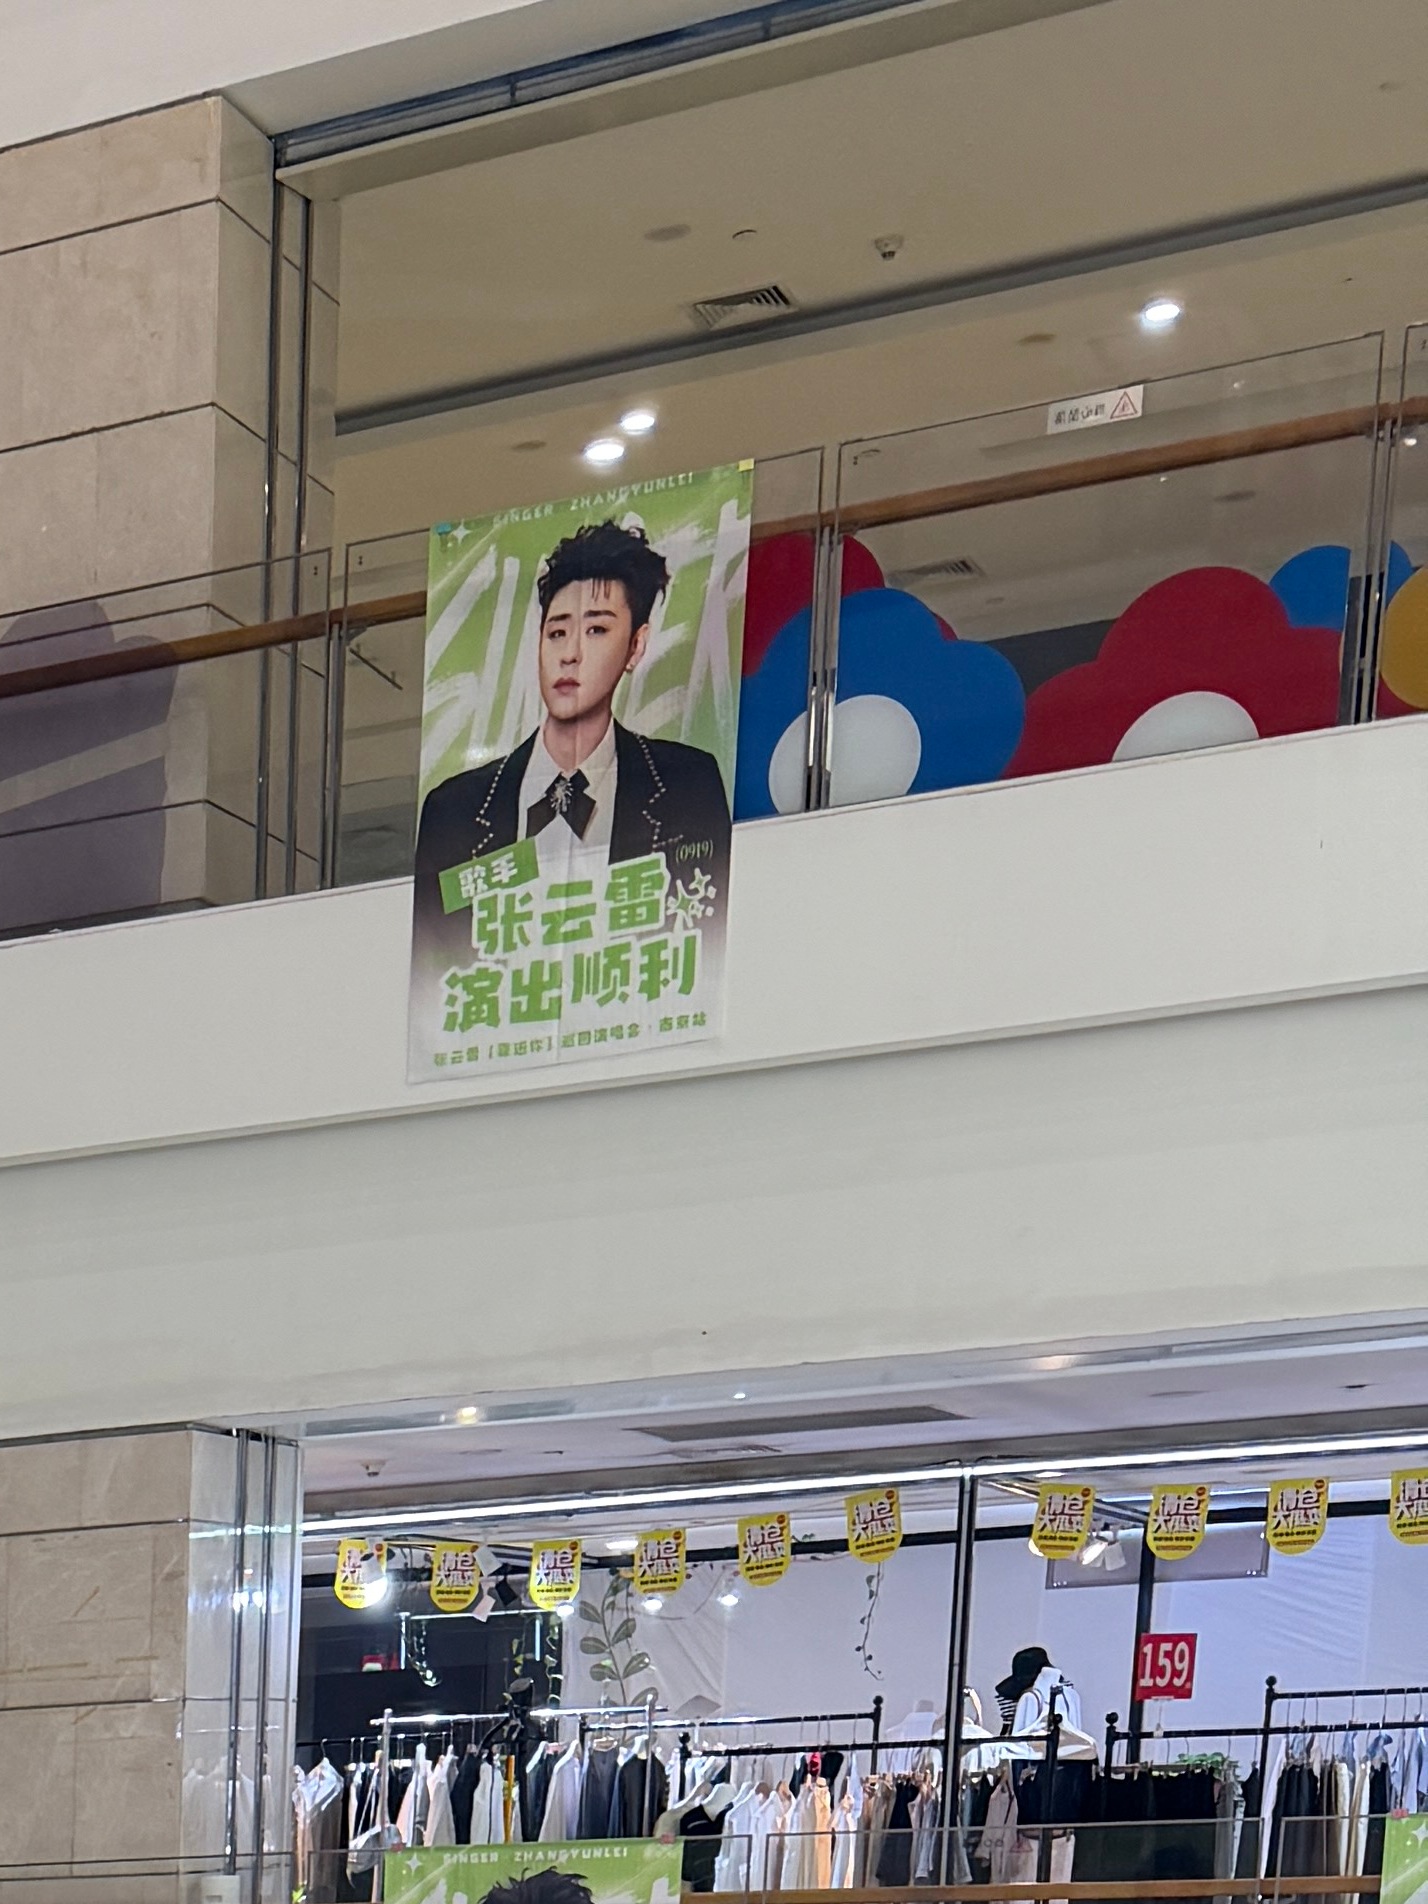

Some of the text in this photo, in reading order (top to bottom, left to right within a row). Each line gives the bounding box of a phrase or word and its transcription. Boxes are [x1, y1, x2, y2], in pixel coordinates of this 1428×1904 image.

[458, 853, 518, 898] 歌手
[675, 839, 714, 864] (0919)
[475, 858, 667, 956] 张云雷
[443, 934, 697, 1033] 演出顺利
[1139, 1640, 1190, 1688] 159
